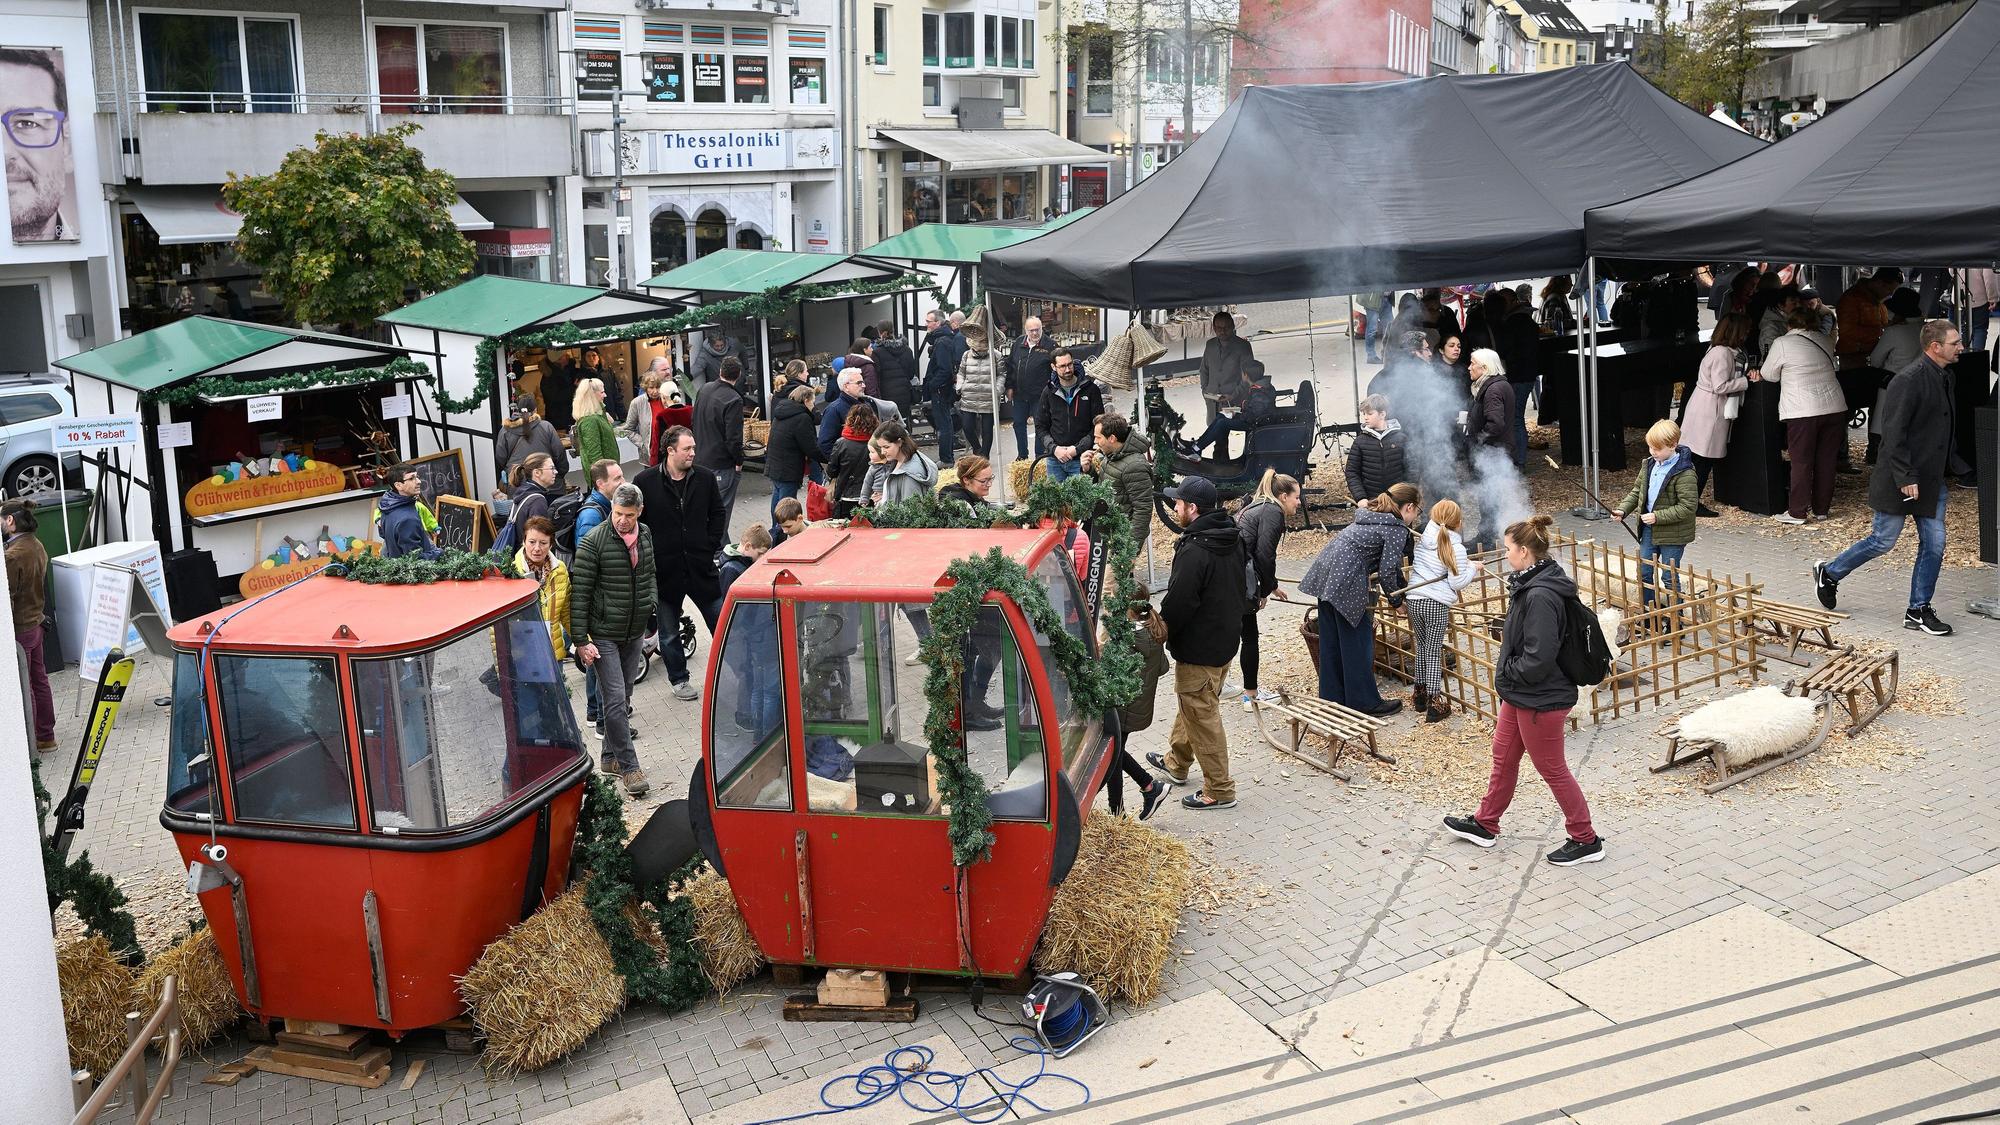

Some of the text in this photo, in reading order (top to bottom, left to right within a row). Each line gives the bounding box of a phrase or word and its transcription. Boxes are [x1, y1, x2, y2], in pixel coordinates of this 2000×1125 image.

[694, 65, 721, 80] 123
[663, 132, 781, 149] Thessaloniki
[694, 152, 754, 169] Grill
[67, 429, 126, 442] 10 % Rabatt
[194, 473, 337, 507] Glühwein & Fruchtpunsch
[247, 569, 302, 592] Glühwein
[1088, 540, 1103, 616] OSSIGNOL
[92, 706, 111, 755] ROSSIGNOL
